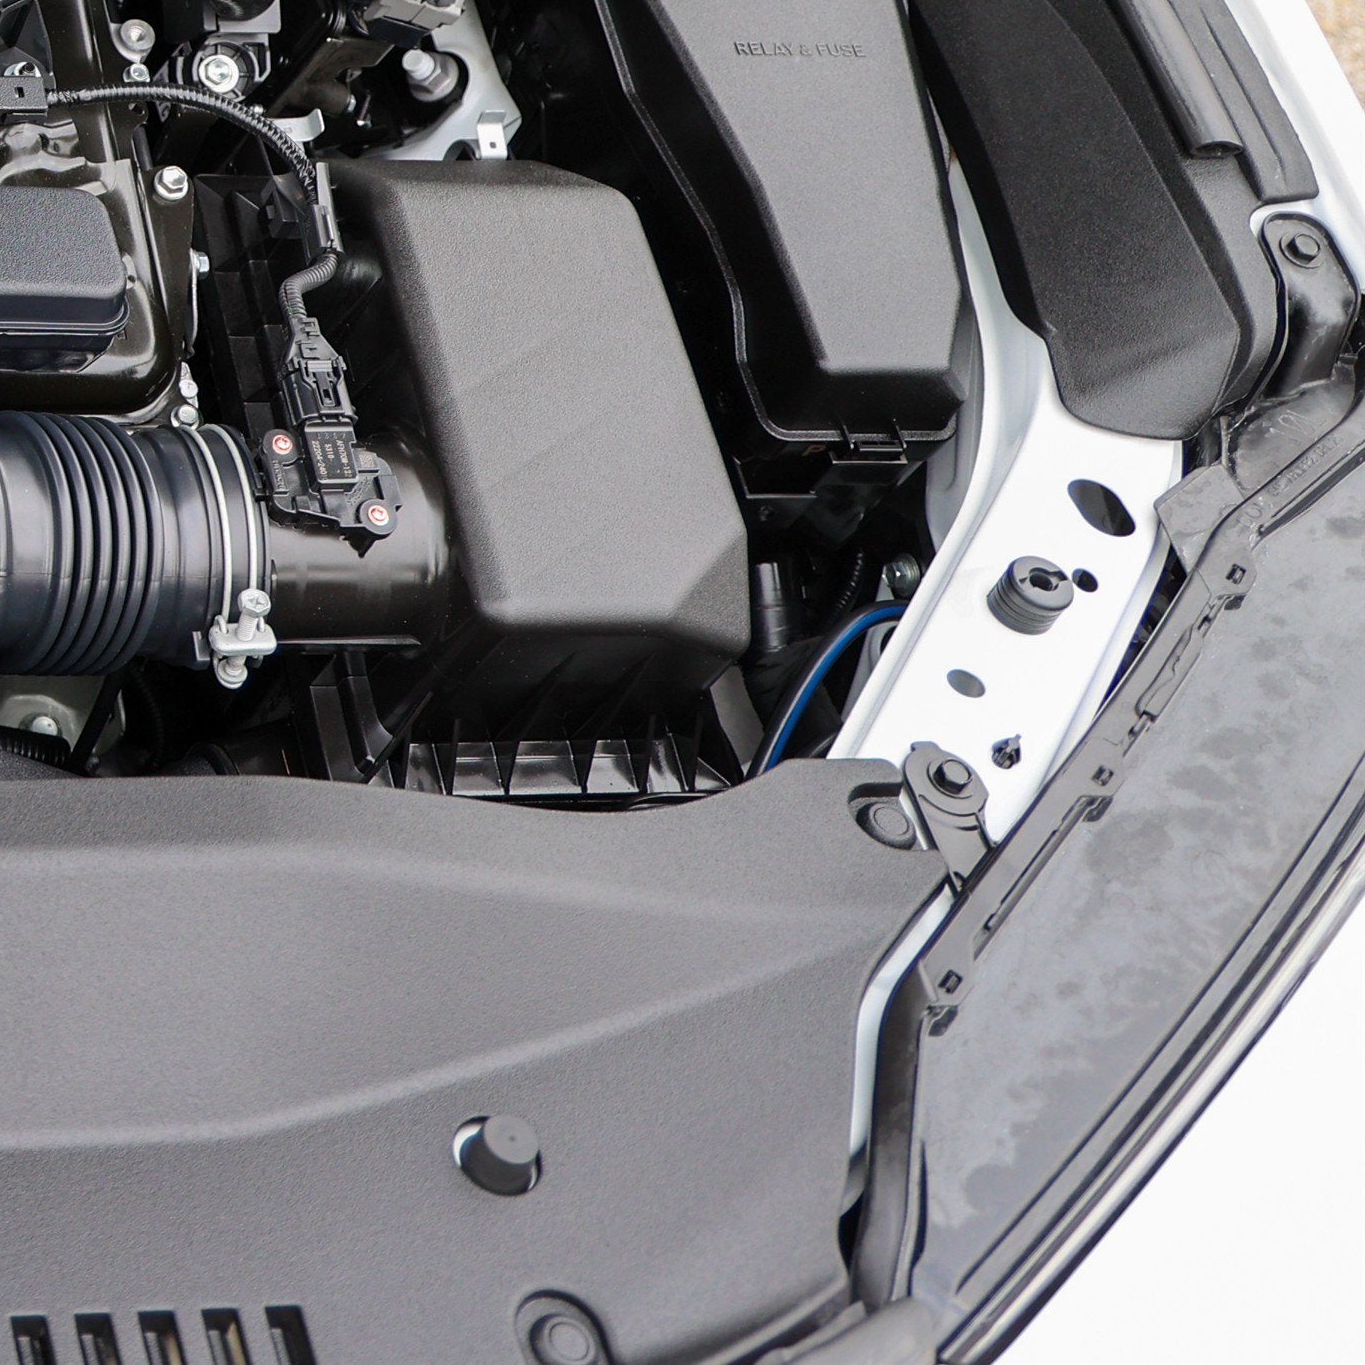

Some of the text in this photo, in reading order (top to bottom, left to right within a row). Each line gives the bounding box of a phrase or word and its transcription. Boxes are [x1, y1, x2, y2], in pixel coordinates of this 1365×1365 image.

[734, 41, 866, 58] RELAY & FUSE
